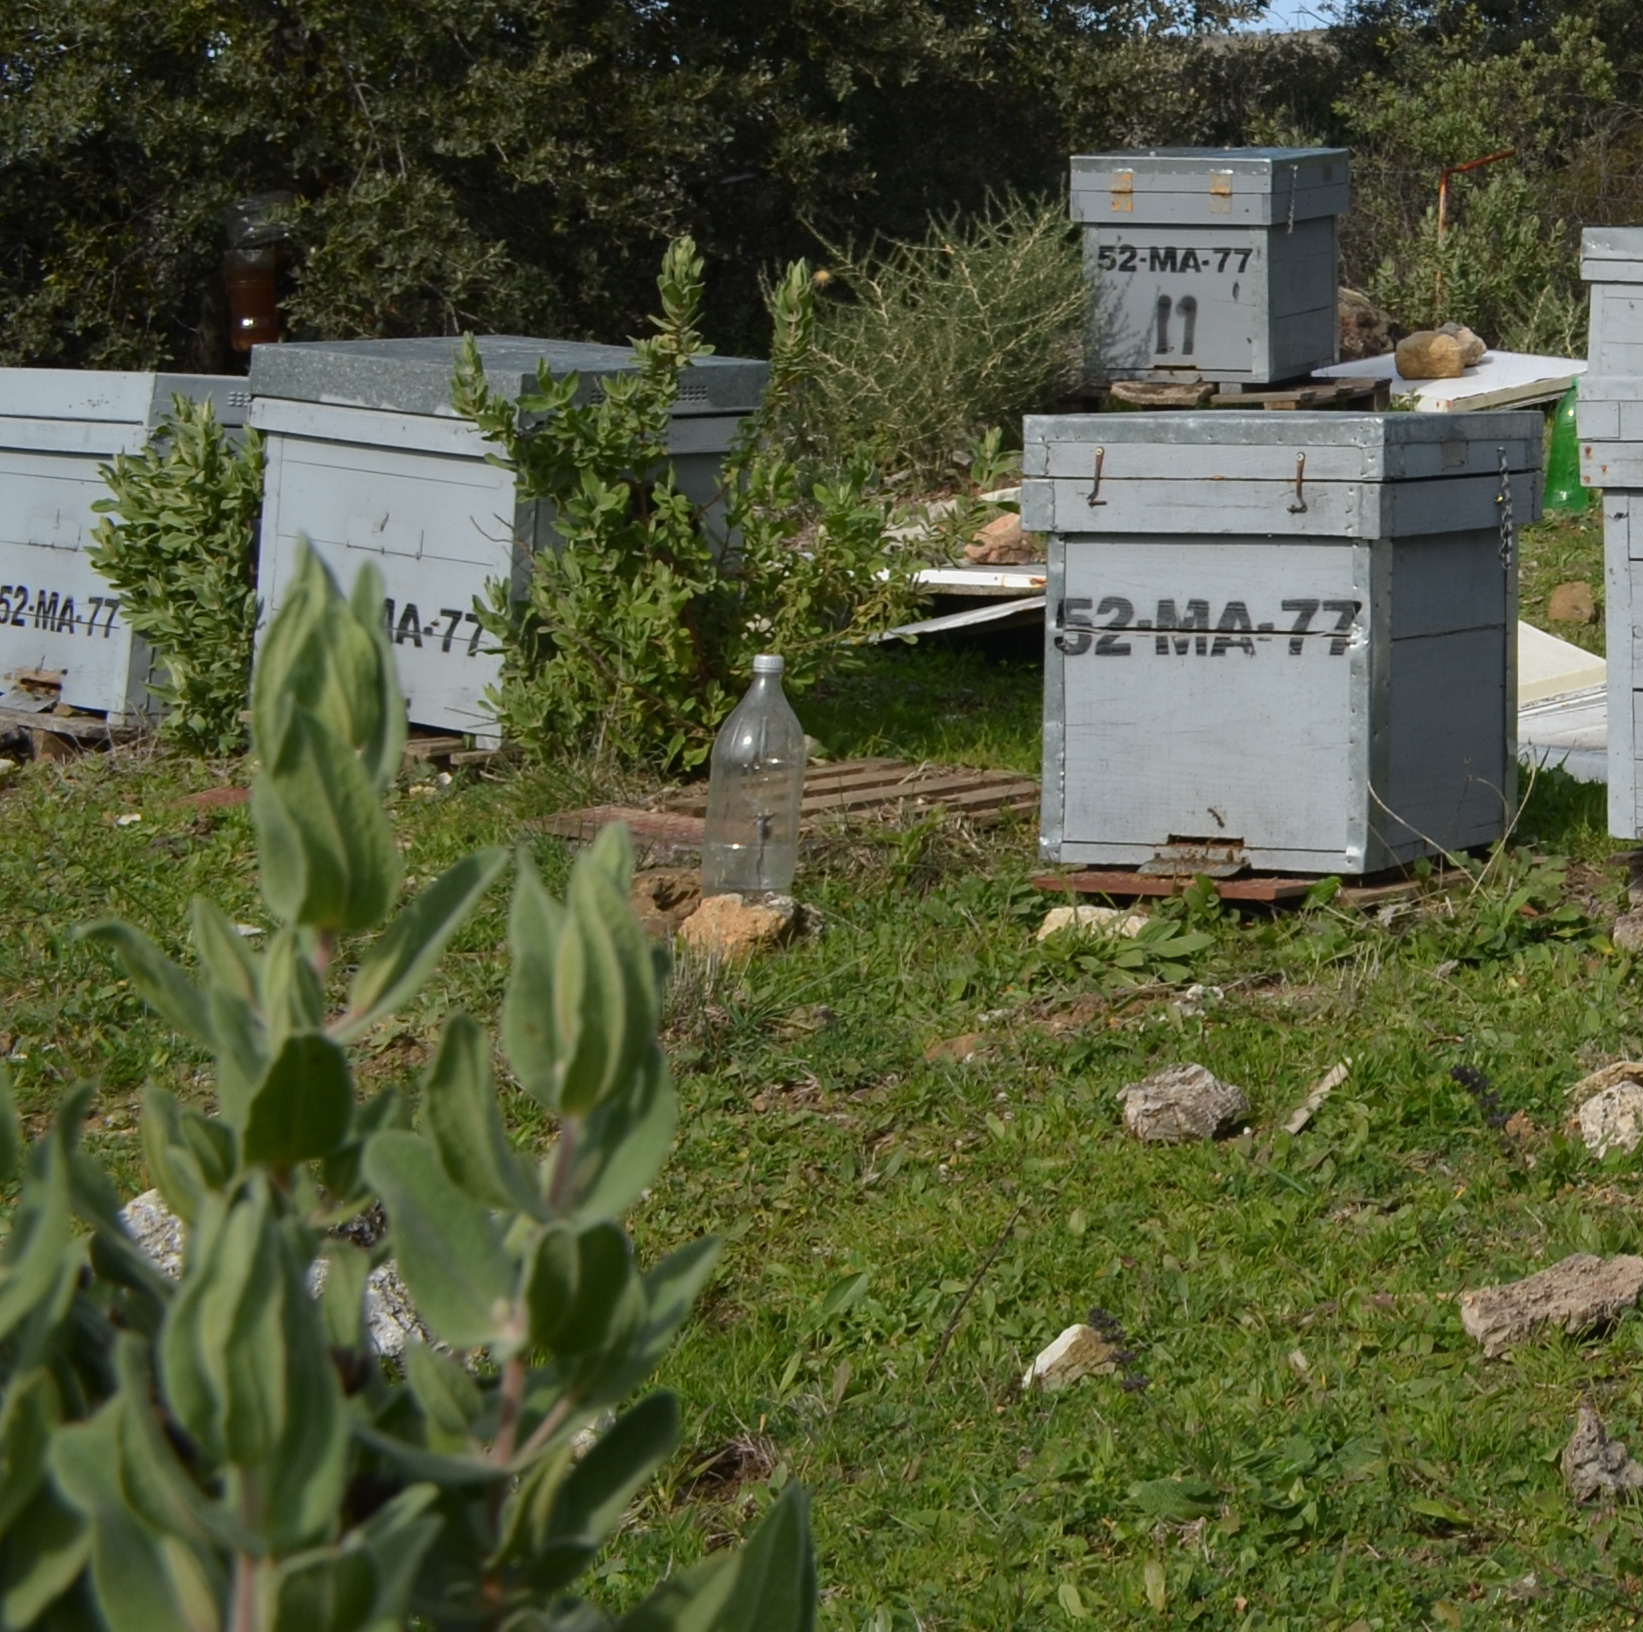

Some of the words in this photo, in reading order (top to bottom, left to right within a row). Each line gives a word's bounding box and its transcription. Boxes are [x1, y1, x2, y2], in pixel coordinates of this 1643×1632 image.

[1097, 243, 1253, 274] 52-MA-77
[0, 585, 120, 638] 52-MA-77
[1054, 596, 1362, 656] 52-MA-77
